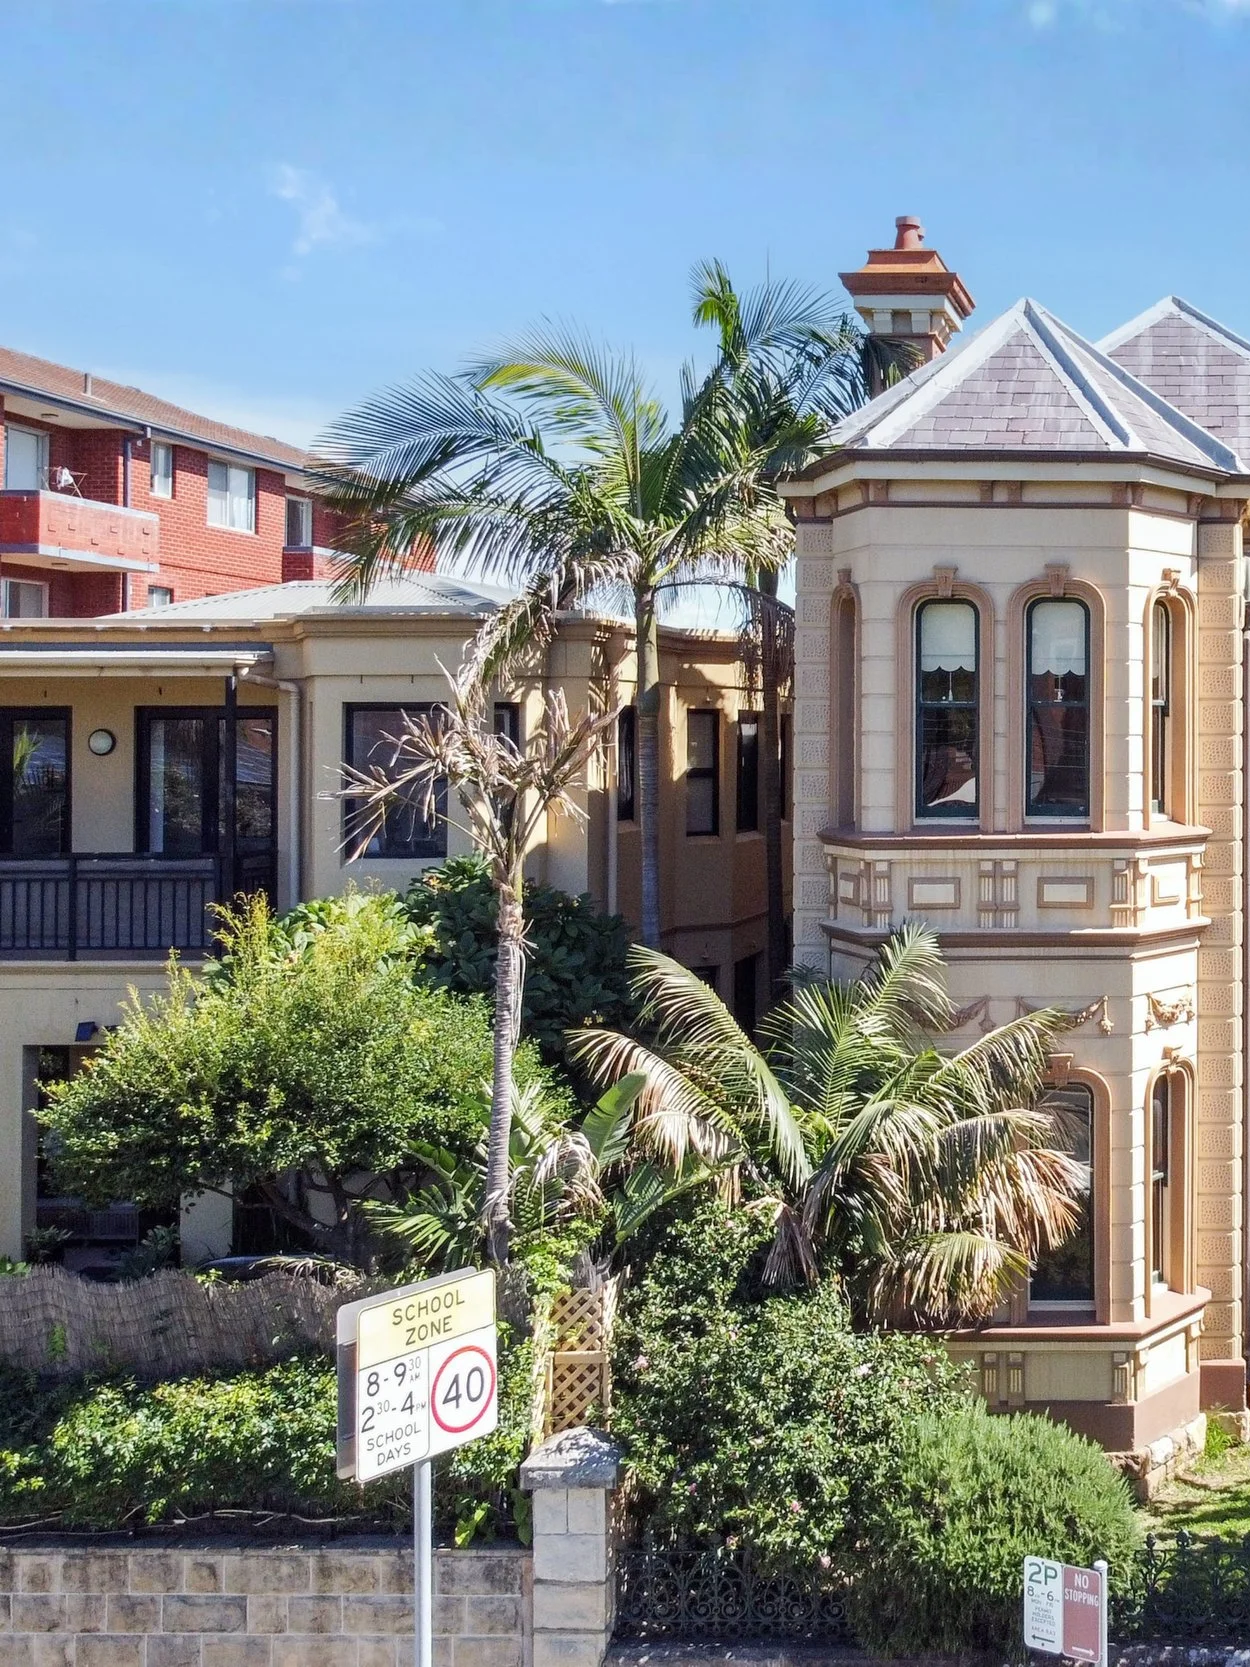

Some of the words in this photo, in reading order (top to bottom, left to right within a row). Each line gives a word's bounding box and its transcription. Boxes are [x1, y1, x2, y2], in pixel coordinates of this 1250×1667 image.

[392, 1289, 465, 1326] SCHOOL
[405, 1315, 453, 1346] ZONE
[442, 1365, 485, 1409] 40
[366, 1423, 421, 1451] SCHOOL
[376, 1442, 412, 1466] DAYS
[1028, 1562, 1058, 1585] 2P
[1074, 1573, 1089, 1589] NO
[1064, 1588, 1099, 1607] STOPPING
